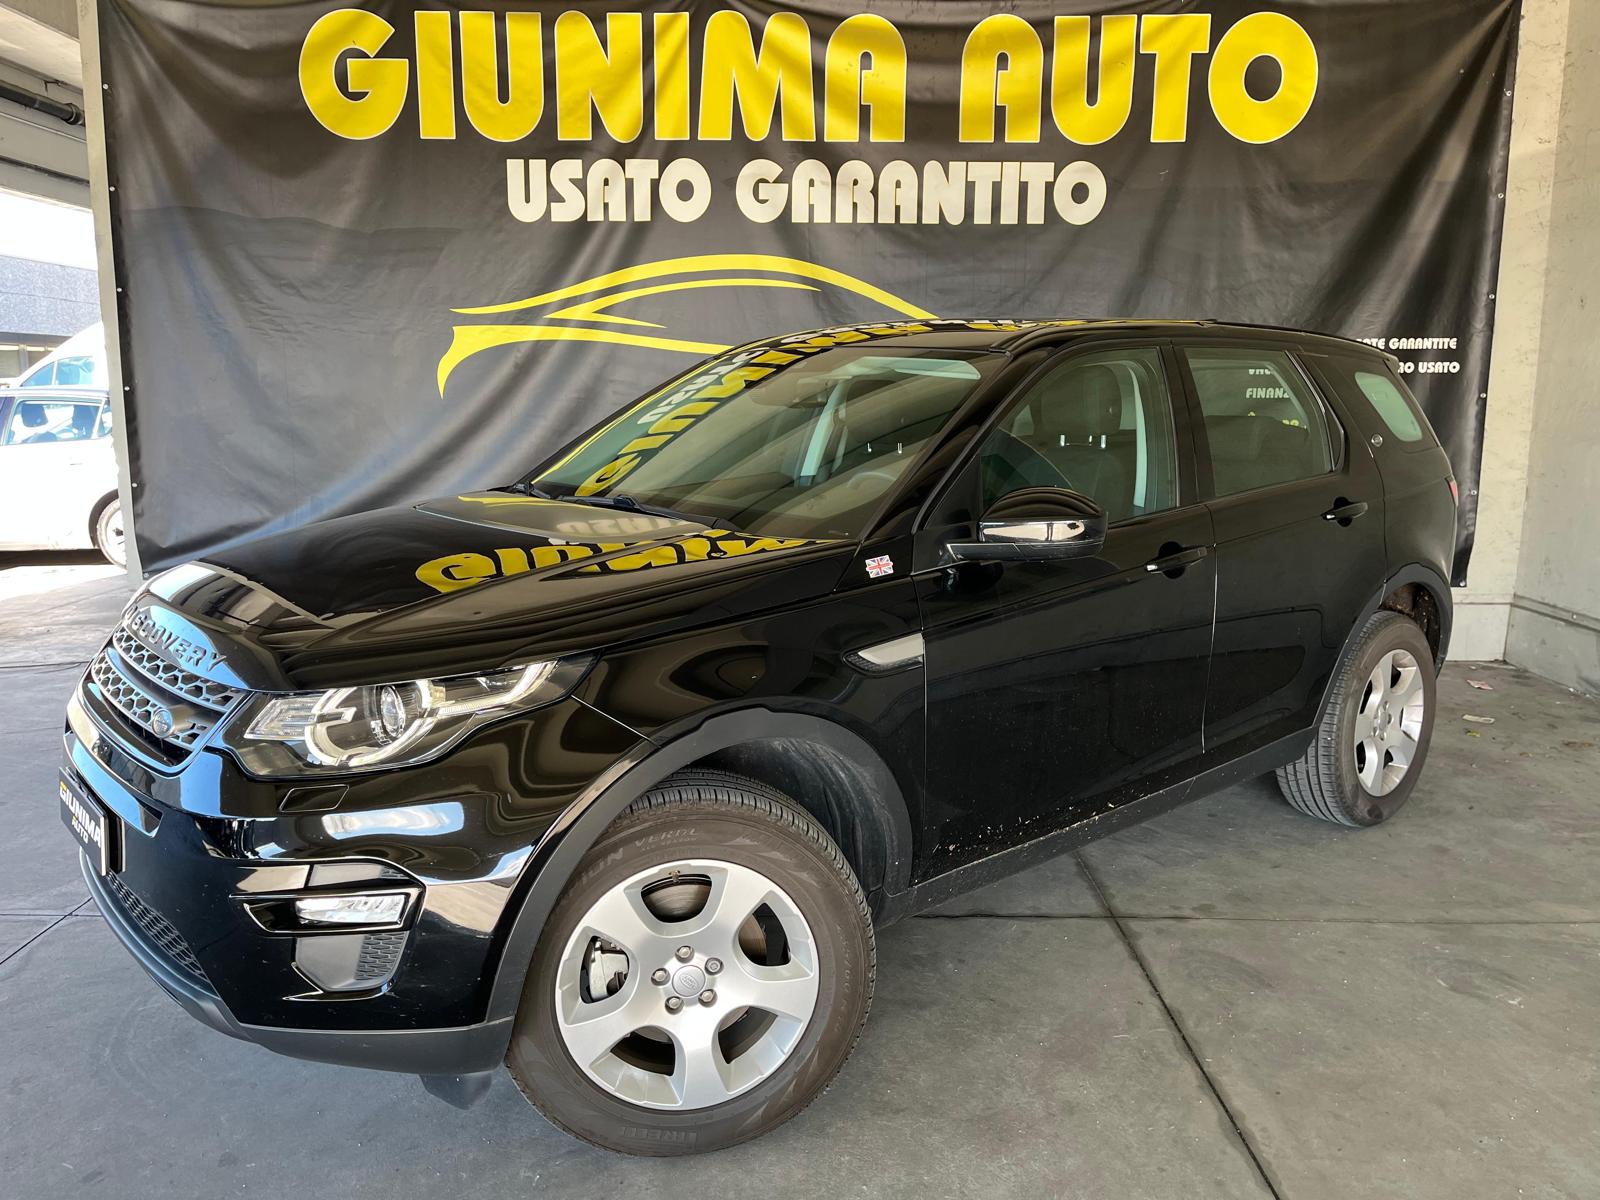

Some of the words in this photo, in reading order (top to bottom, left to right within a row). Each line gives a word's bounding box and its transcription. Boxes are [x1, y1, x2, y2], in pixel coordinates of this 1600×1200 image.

[298, 8, 908, 143] GIUNIMA
[959, 11, 1319, 145] AUTO
[506, 157, 713, 224] USATO
[735, 158, 1107, 226] GARANTITO
[1388, 337, 1458, 350] GARANTITE
[1418, 361, 1461, 374] USATO
[60, 781, 101, 849] GIUNIMA
[71, 815, 89, 844] AUTO
